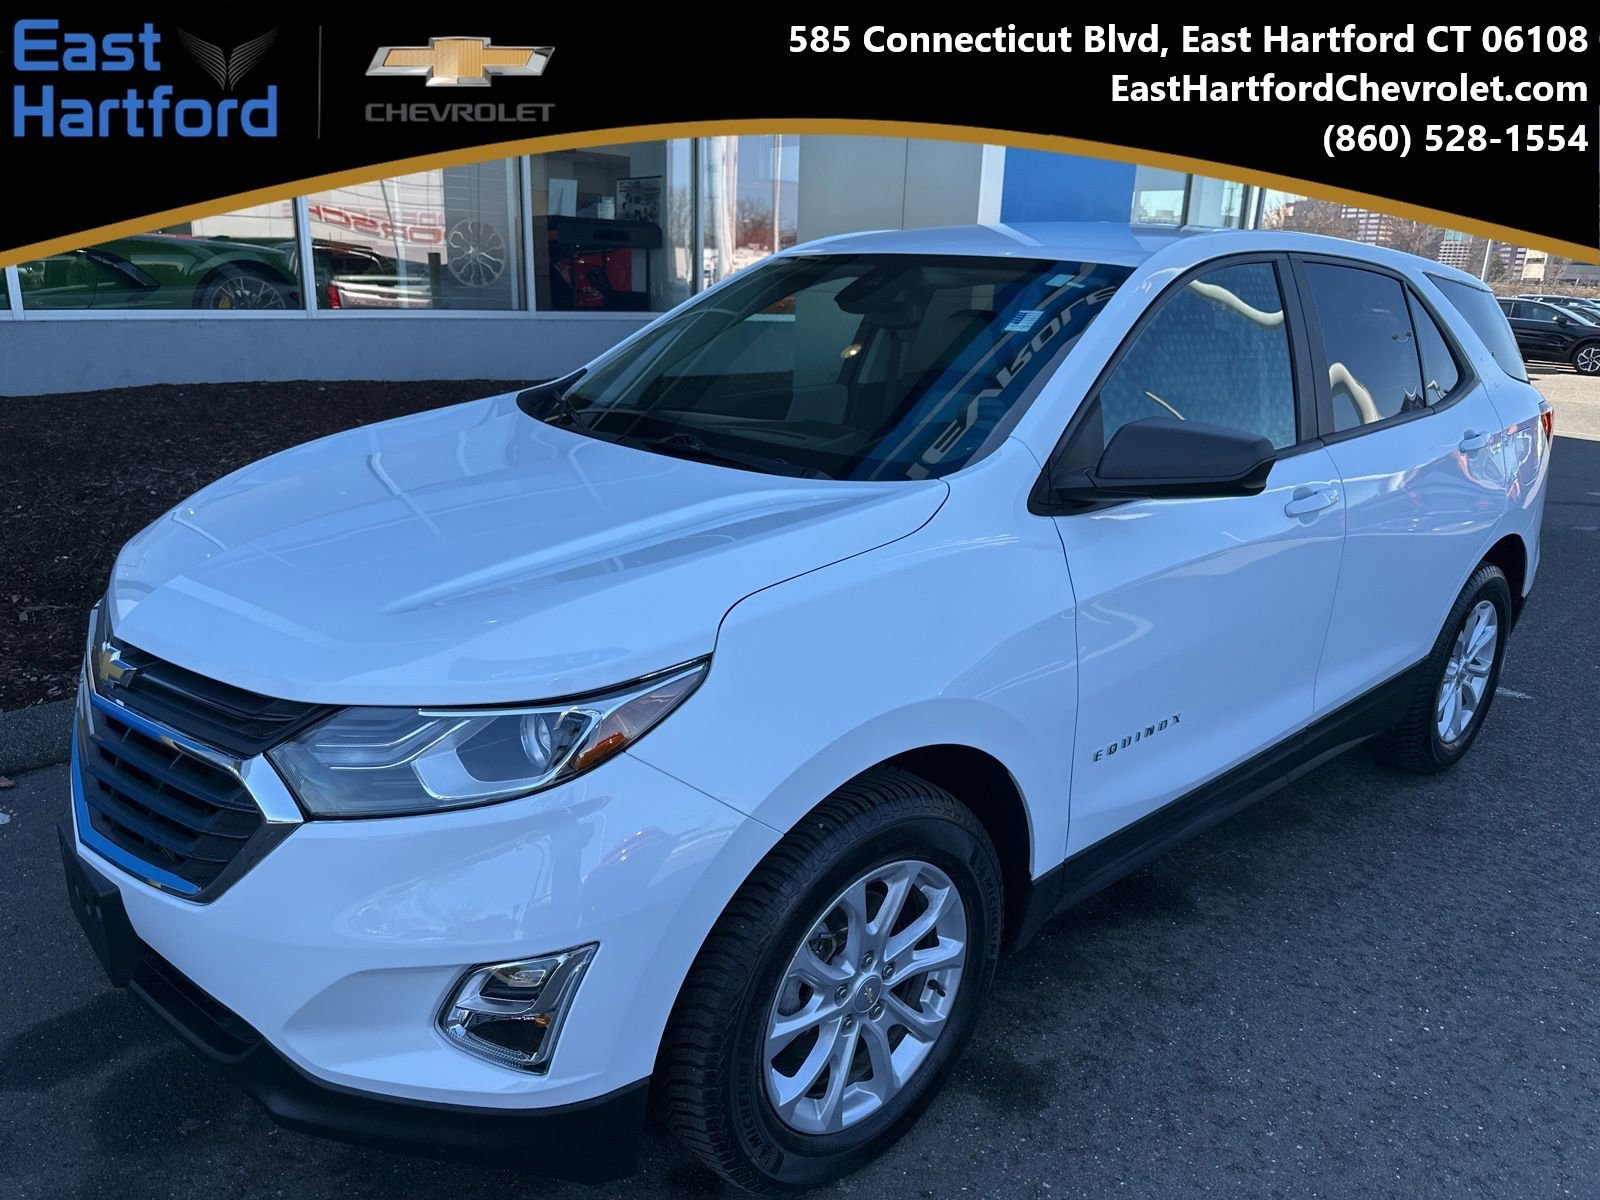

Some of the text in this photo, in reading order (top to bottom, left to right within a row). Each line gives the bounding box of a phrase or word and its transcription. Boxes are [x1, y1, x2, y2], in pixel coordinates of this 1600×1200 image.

[1093, 712, 1181, 763] EQUINOX
[982, 876, 1000, 958] MICHELIN
[737, 1060, 763, 1149] MICHELIN
